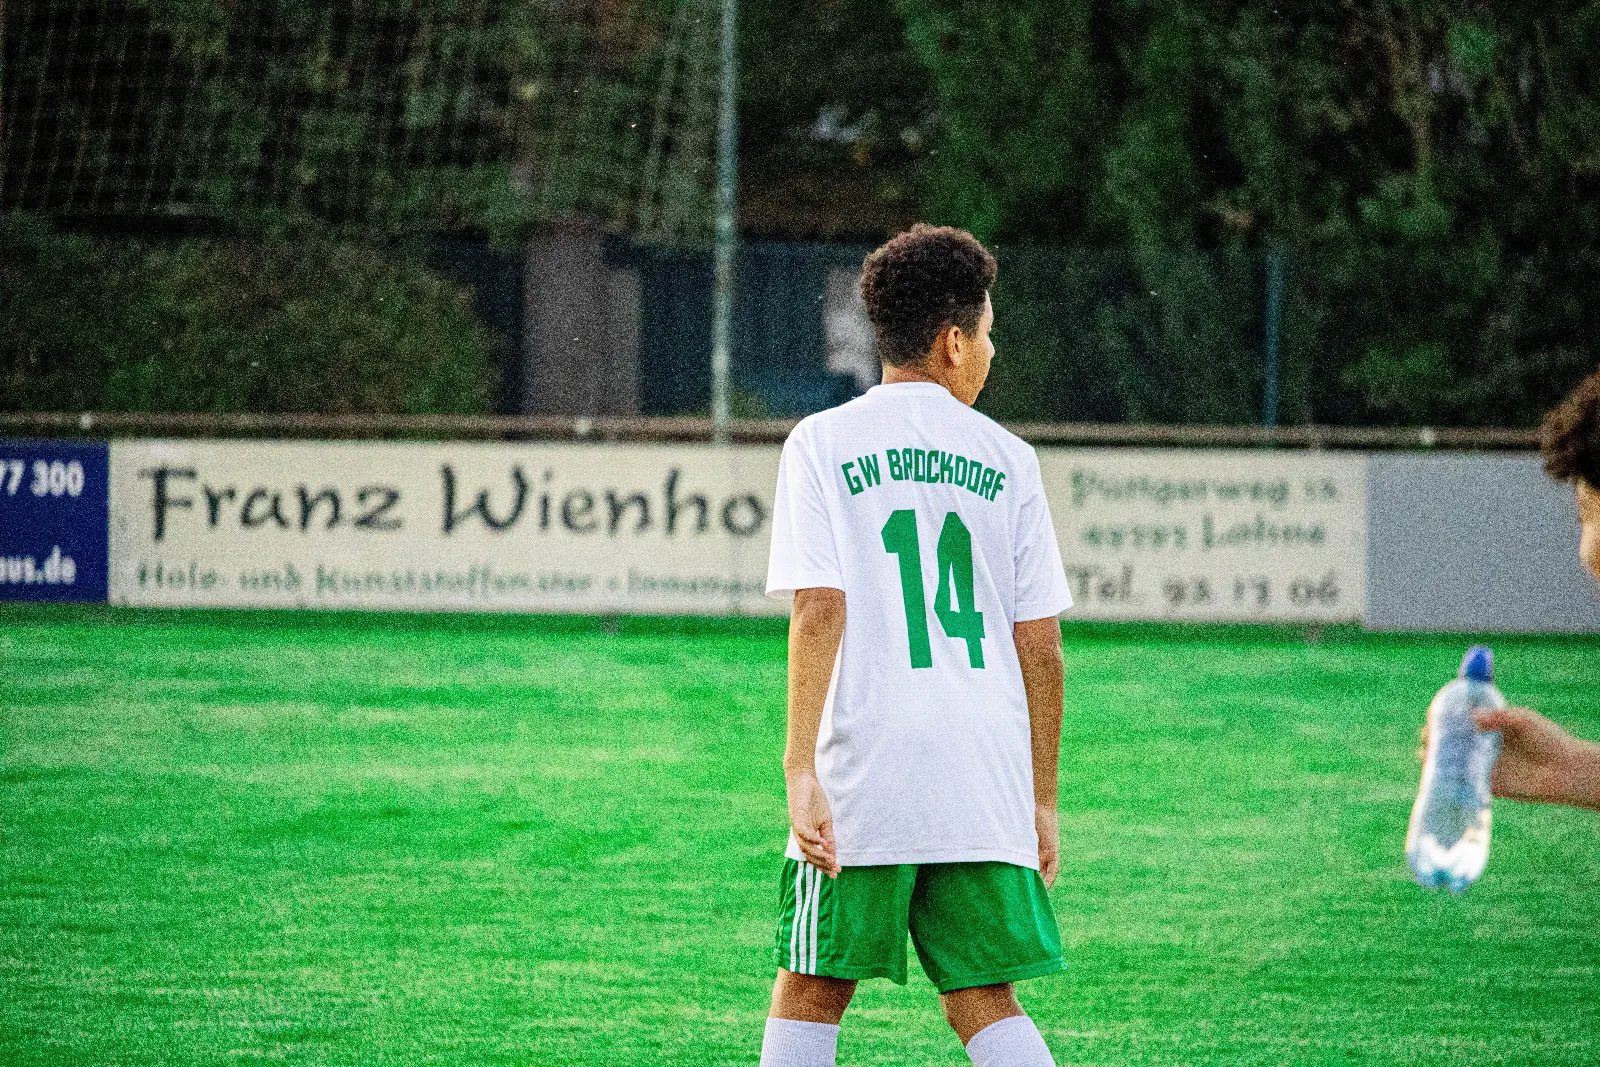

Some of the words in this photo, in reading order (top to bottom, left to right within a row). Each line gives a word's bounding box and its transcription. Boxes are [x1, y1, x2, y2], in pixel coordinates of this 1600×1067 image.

[30, 459, 85, 497] 300
[841, 453, 882, 496] GW
[886, 447, 1007, 502] BROCKDORF
[138, 466, 403, 541] Franz
[238, 561, 302, 591] und
[881, 508, 986, 670] 14
